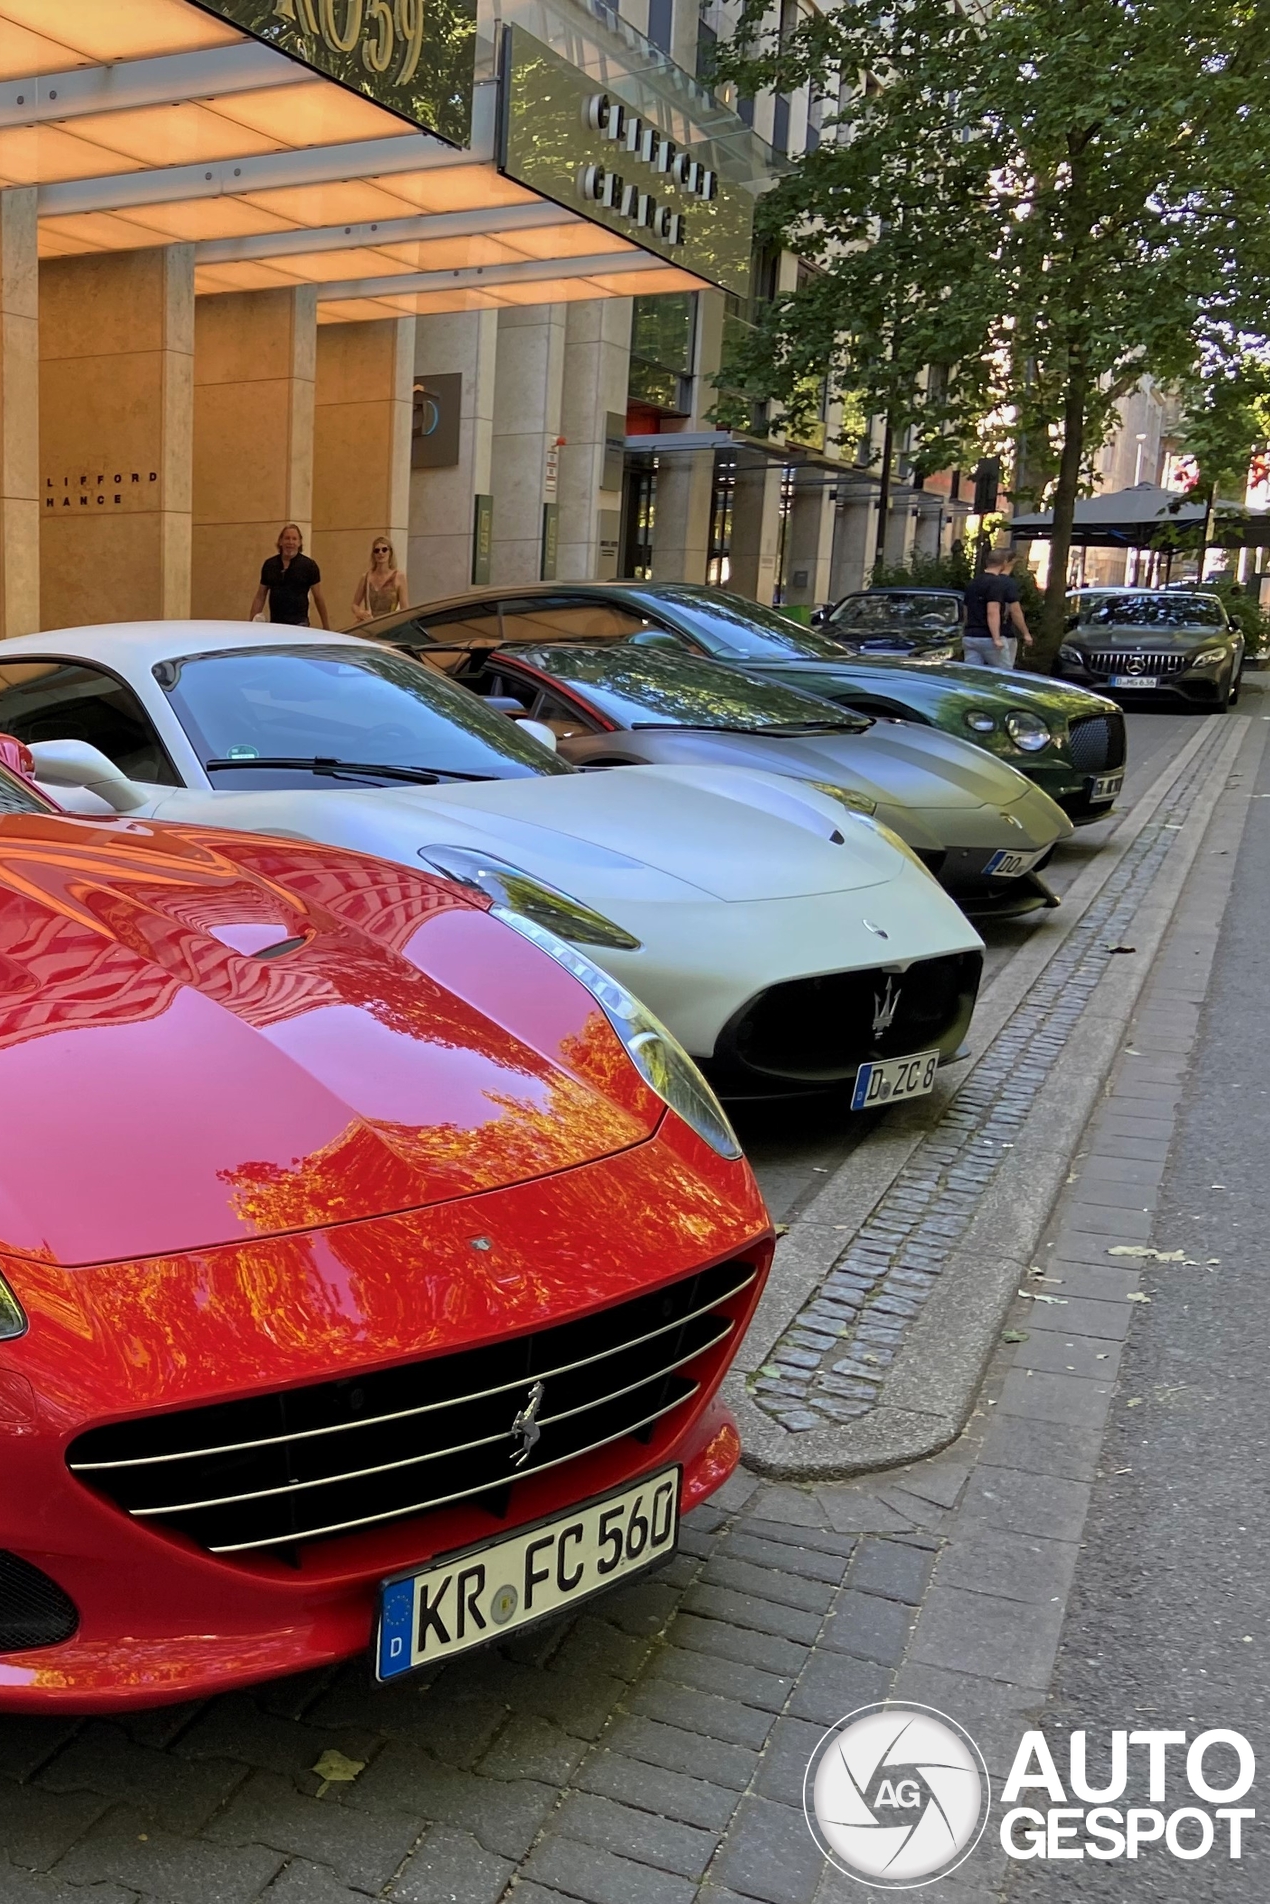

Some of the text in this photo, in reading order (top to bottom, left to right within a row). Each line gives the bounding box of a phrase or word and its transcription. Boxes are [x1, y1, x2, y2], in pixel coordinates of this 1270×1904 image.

[587, 94, 718, 200] CLIFFORD
[583, 164, 686, 246] CHANCE
[996, 856, 1022, 873] DO
[867, 1058, 936, 1100] D ZC 8
[417, 1481, 673, 1652] KR FC 560
[390, 1637, 402, 1657] D
